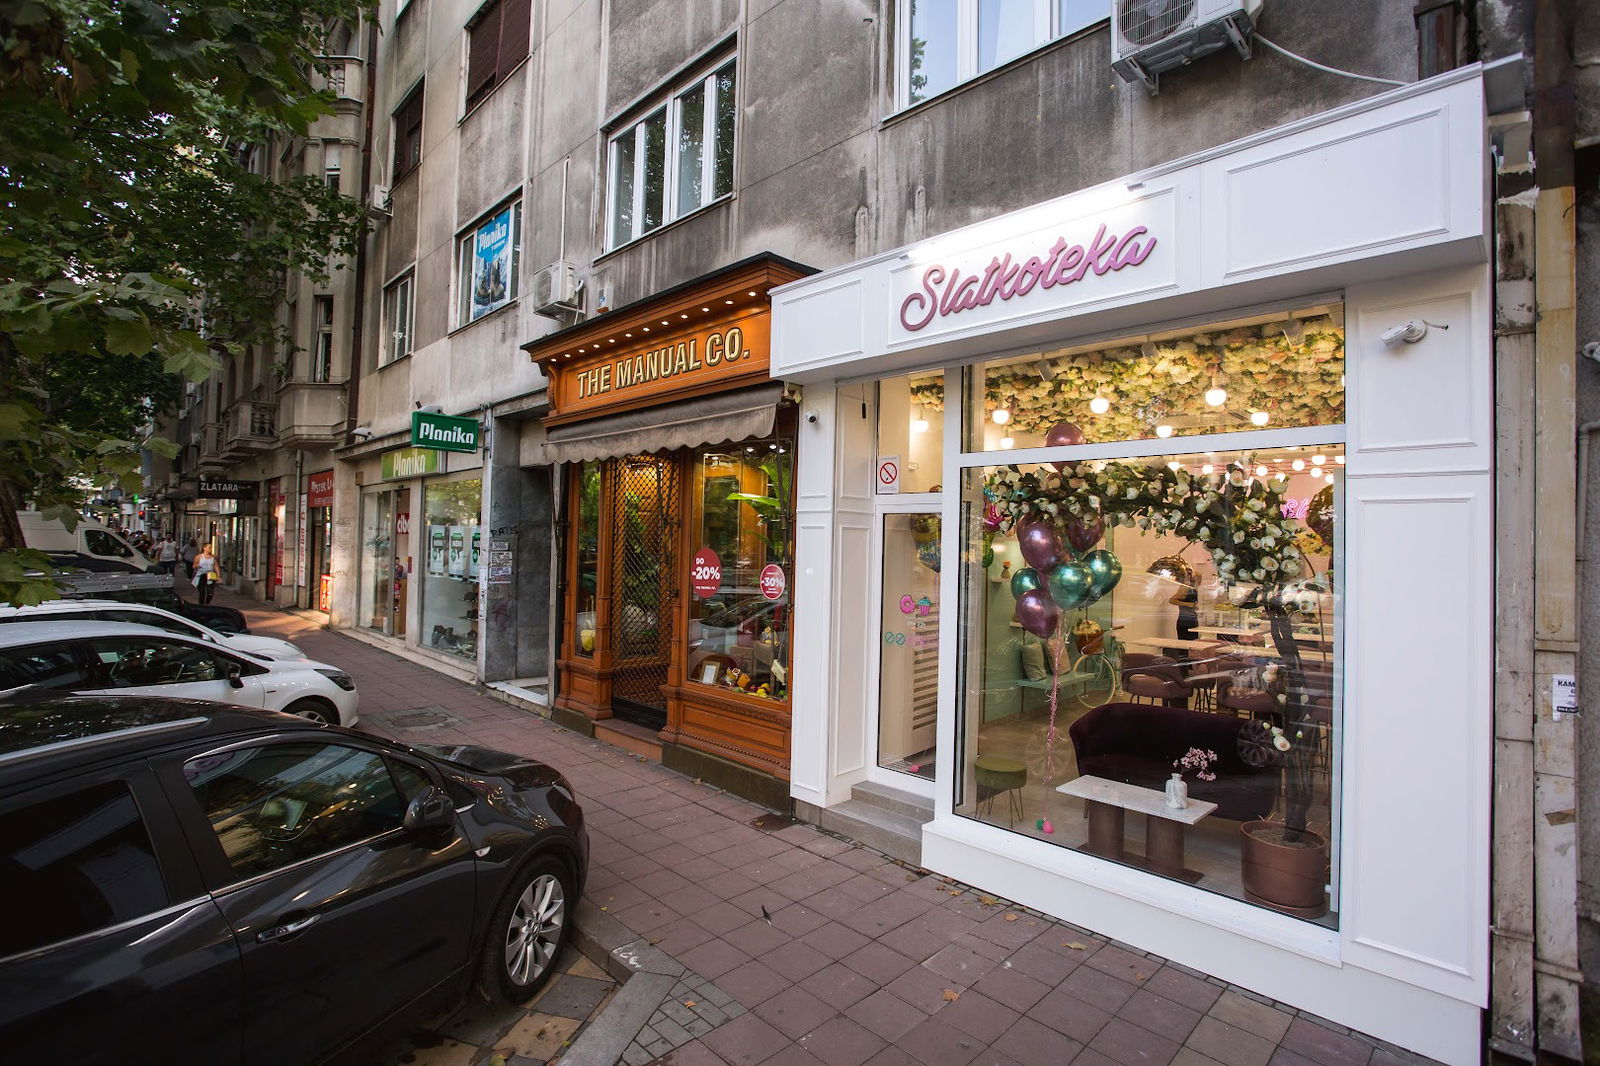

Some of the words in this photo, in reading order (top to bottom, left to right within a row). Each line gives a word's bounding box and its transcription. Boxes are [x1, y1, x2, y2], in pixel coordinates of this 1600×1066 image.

[899, 223, 1157, 332] Slatkoteka
[577, 364, 611, 400] THE
[615, 339, 702, 391] MANUAL
[704, 326, 751, 368] CO.
[419, 422, 475, 445] Planika
[392, 448, 427, 478] Planika
[200, 482, 239, 492] ZLATARA
[695, 557, 705, 565] DO
[691, 566, 721, 580] -20%
